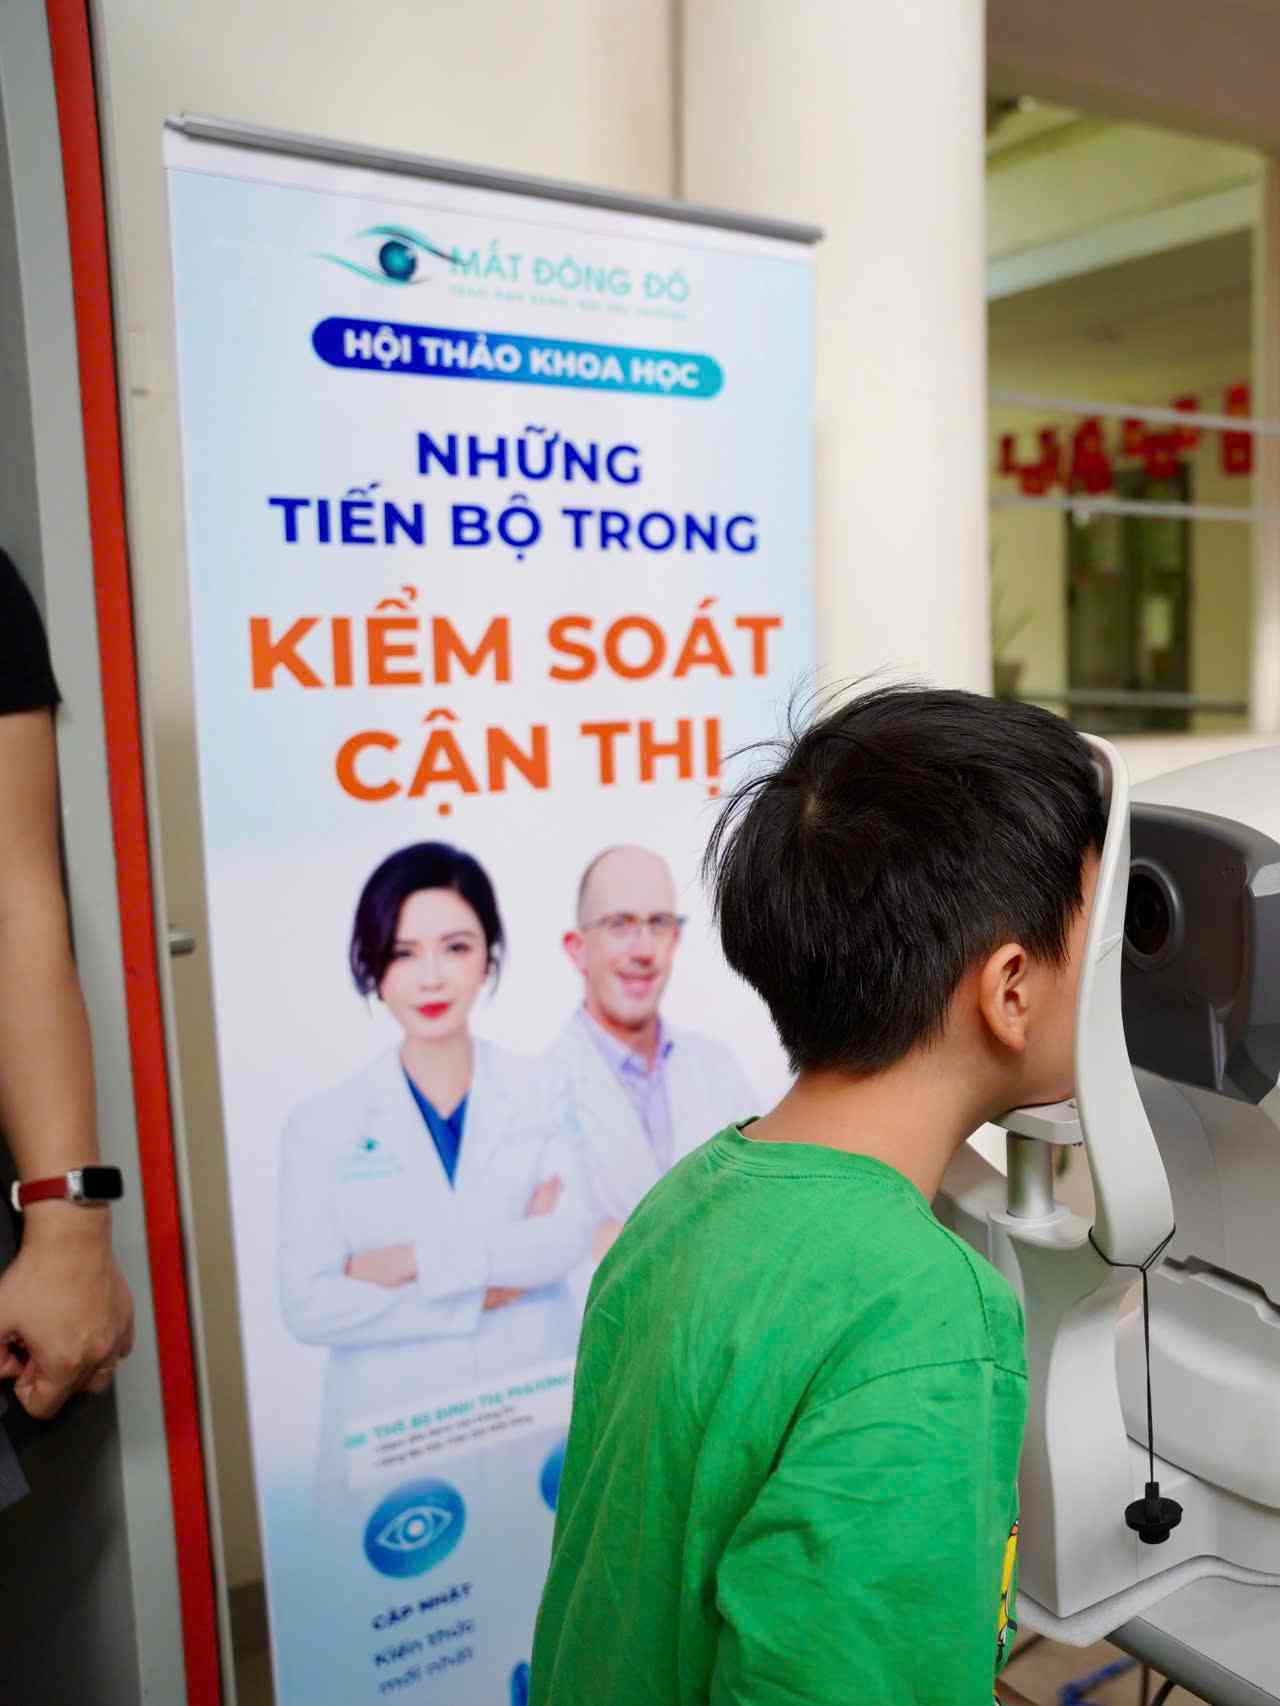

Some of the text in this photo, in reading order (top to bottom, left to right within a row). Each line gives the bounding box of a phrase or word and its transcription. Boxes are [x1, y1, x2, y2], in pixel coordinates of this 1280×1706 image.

[532, 254, 632, 297] ĐÔNG
[344, 328, 698, 391] HỘI THẢO KHOA HỌC
[416, 425, 641, 486] NHỮNG
[268, 482, 759, 560] TIẾN BỘ TRONG
[249, 585, 784, 690] KIỂM SOÁT
[335, 708, 721, 816] CẬN THỊ
